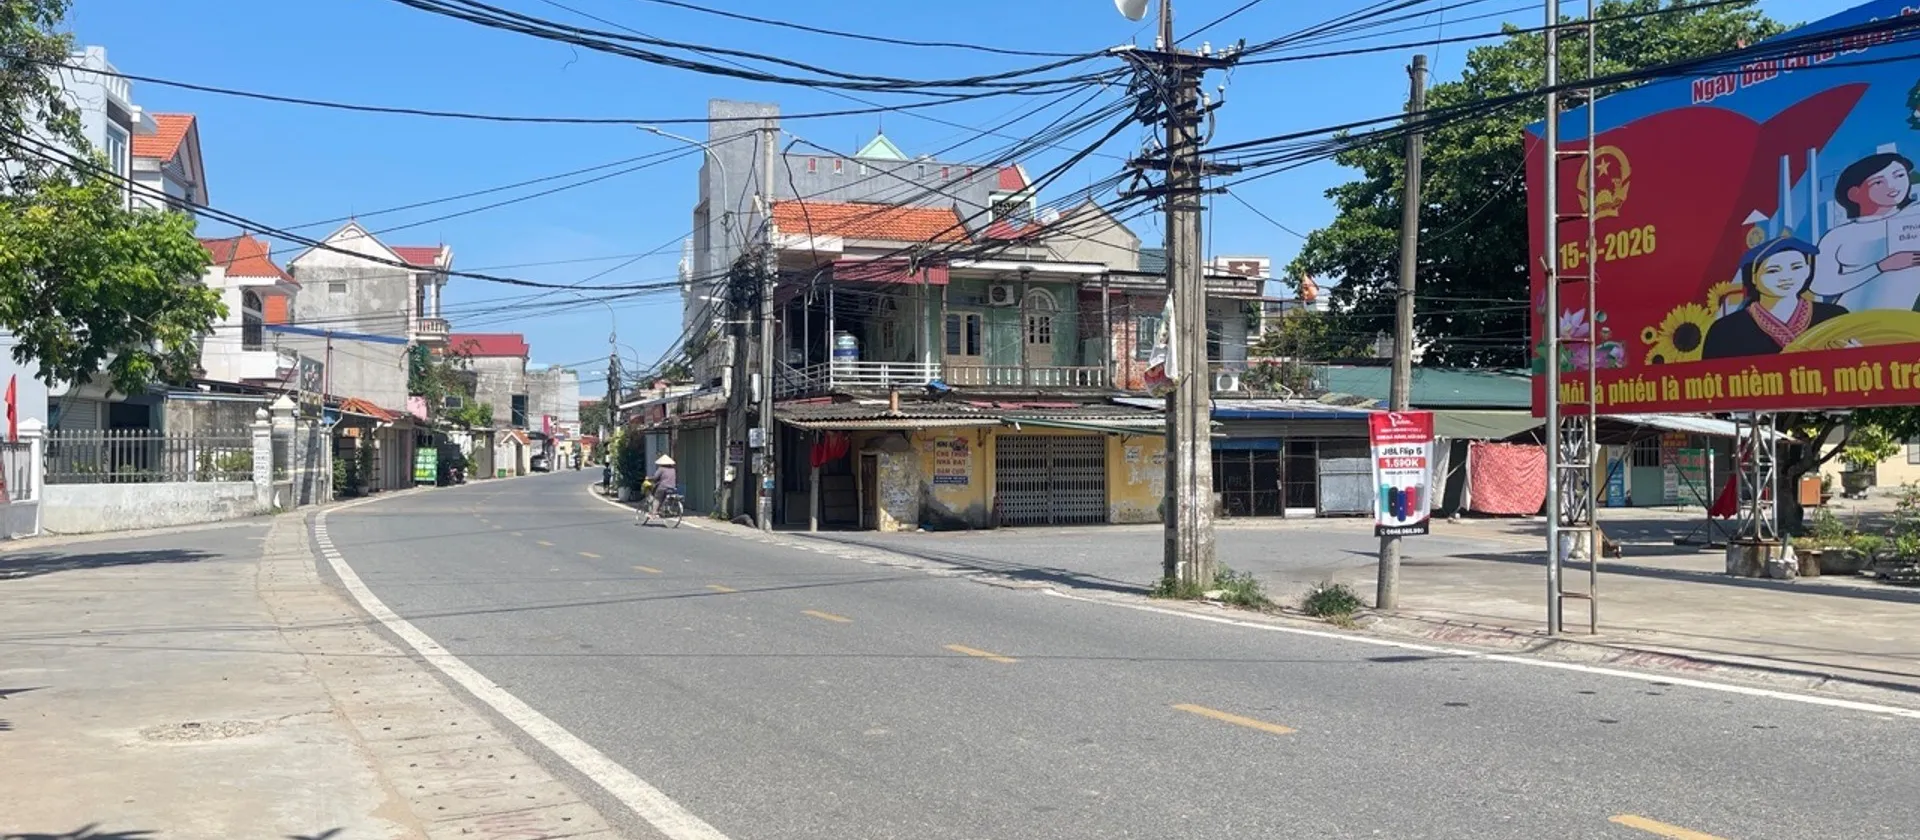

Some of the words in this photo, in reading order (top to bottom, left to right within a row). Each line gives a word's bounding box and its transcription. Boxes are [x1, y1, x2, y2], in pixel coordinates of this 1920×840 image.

[1608, 374, 1657, 406] phiếu
[1662, 375, 1679, 400] là
[1684, 372, 1724, 403] một
[1729, 365, 1784, 397] niềm
[1789, 366, 1828, 396] tin,
[1834, 361, 1884, 397] một
[1382, 447, 1399, 455] JBL
[1400, 447, 1414, 455] Flip
